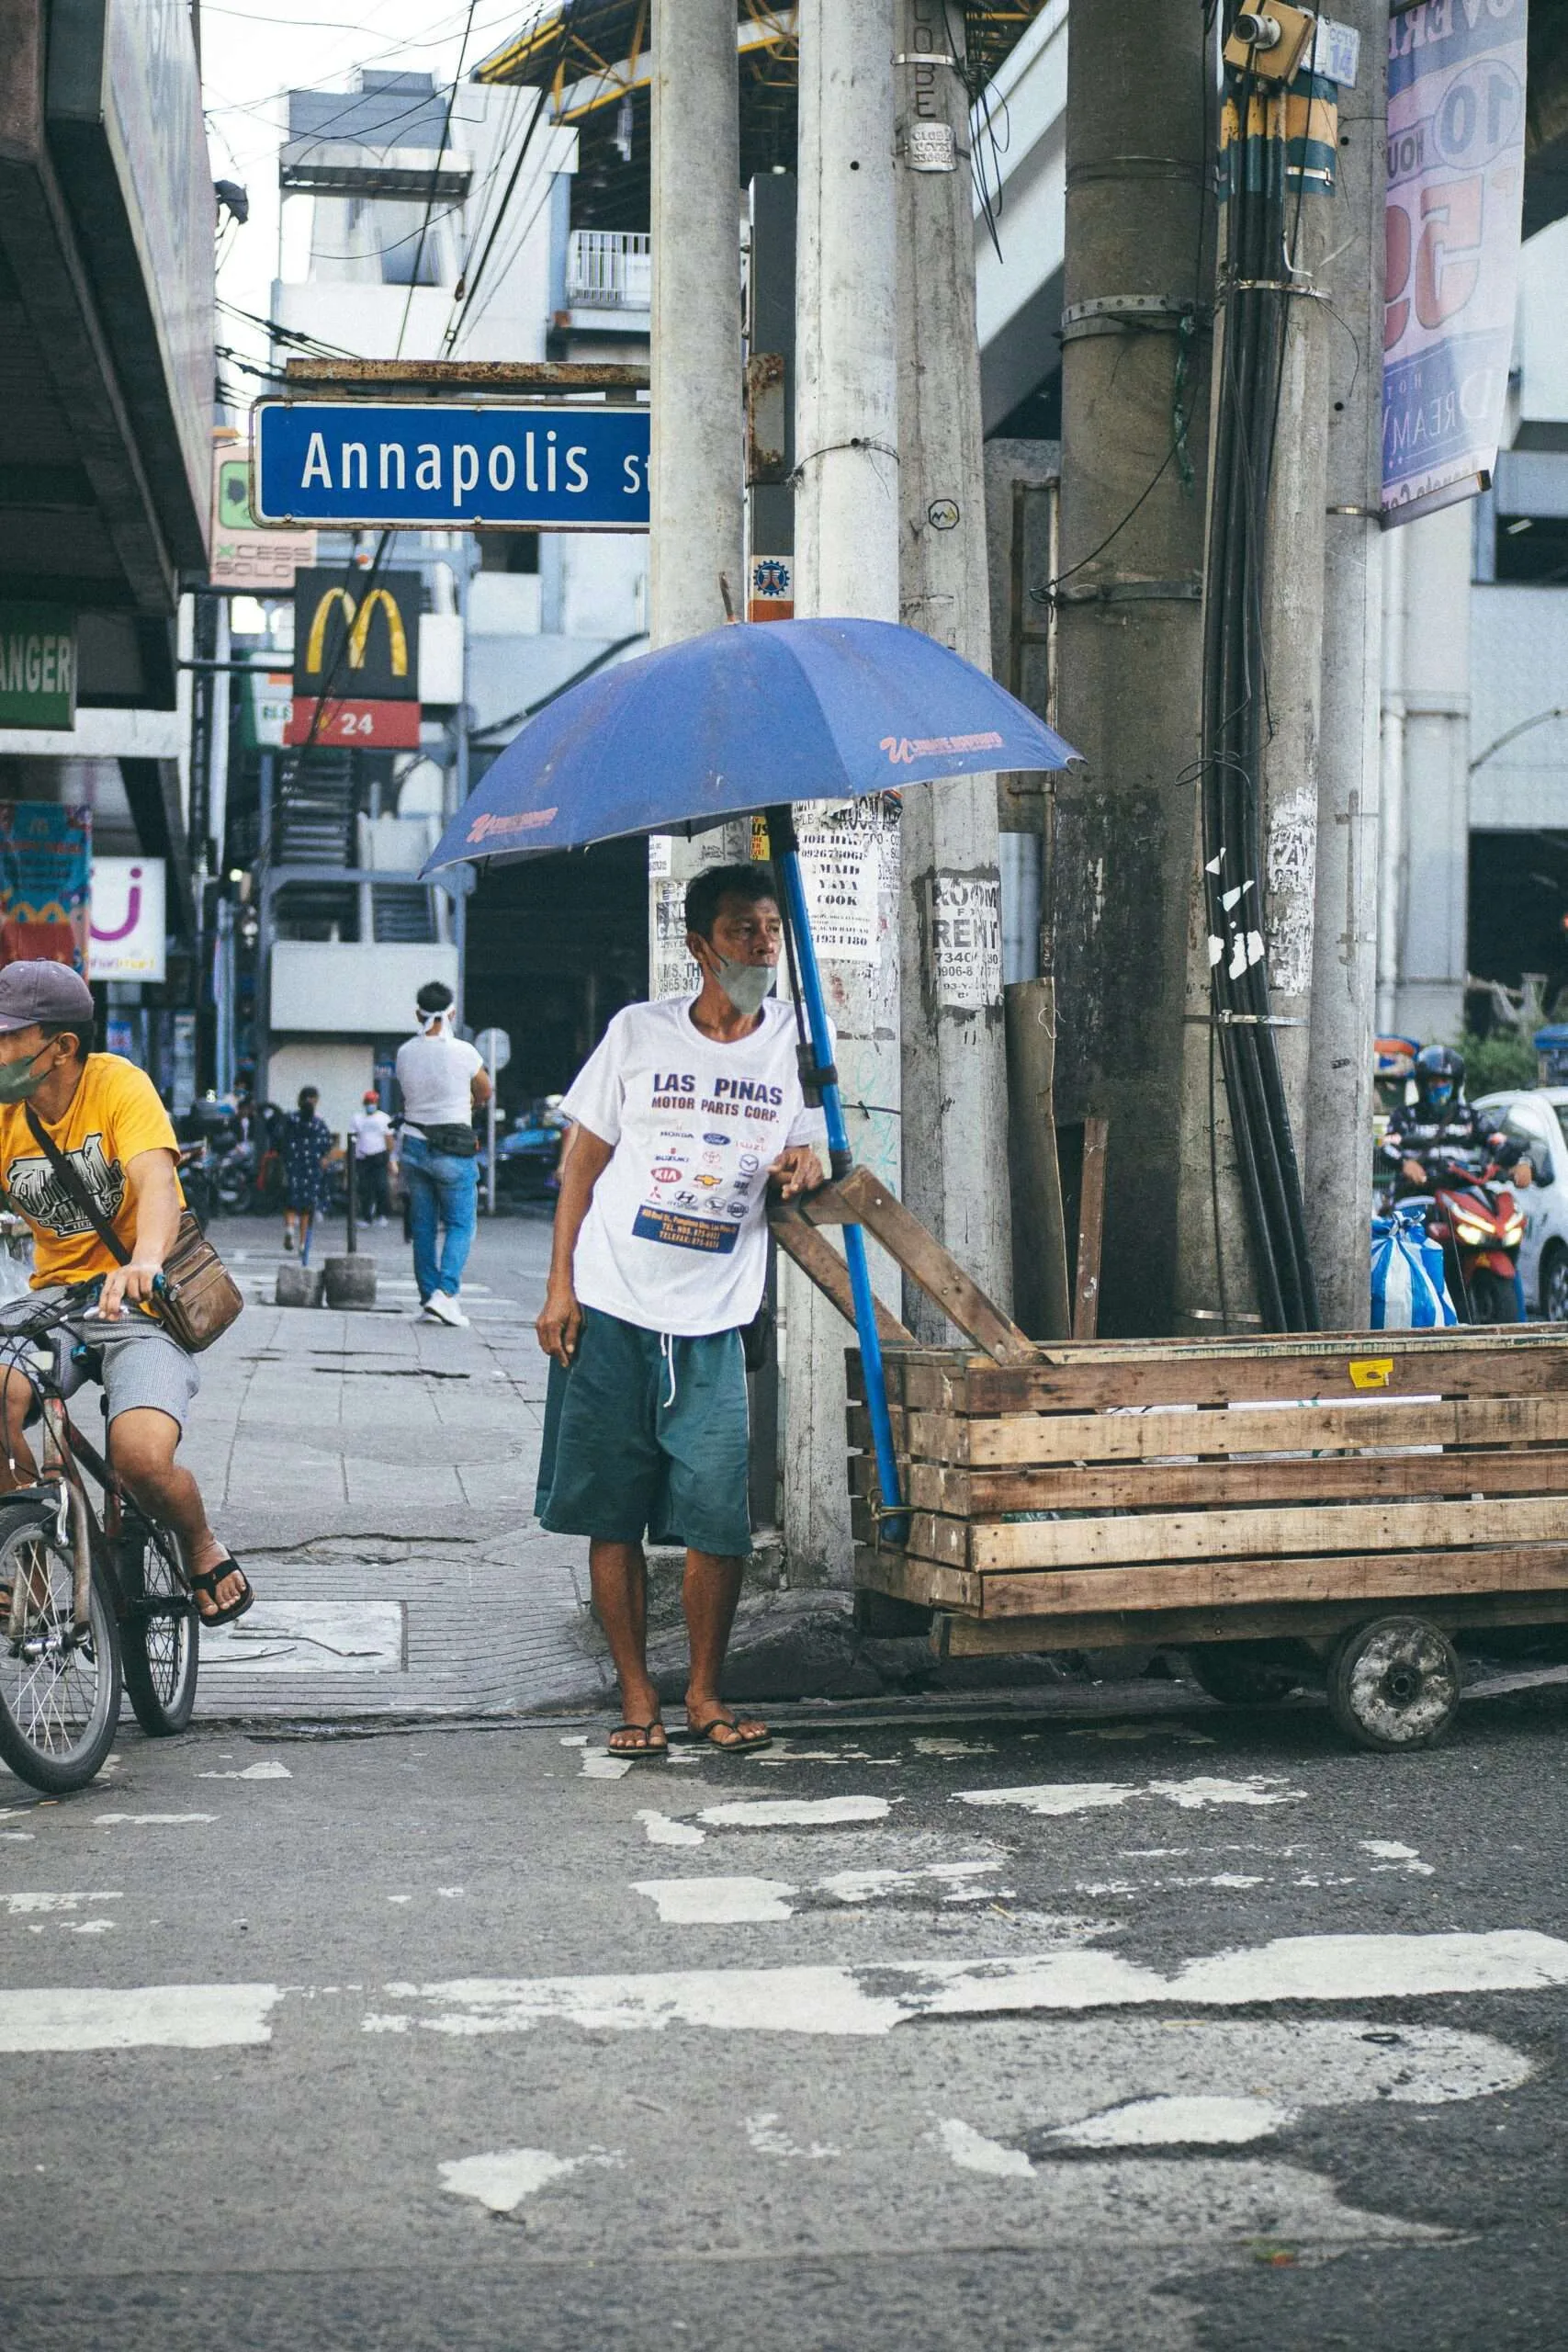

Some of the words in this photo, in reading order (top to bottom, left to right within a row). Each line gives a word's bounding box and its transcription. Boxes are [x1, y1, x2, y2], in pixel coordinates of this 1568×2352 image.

[1330, 28, 1356, 44] CCTV
[1330, 44, 1353, 79] 14
[300, 430, 589, 507] Annapolis
[217, 544, 311, 561] XCESS
[216, 561, 291, 577] SOLO
[341, 712, 374, 735] 24
[653, 1073, 695, 1093] LAS
[651, 1096, 695, 1110] MOTOR
[701, 1099, 739, 1116] PARTS
[744, 1105, 780, 1123] CORP.
[653, 1170, 678, 1182] KIA
